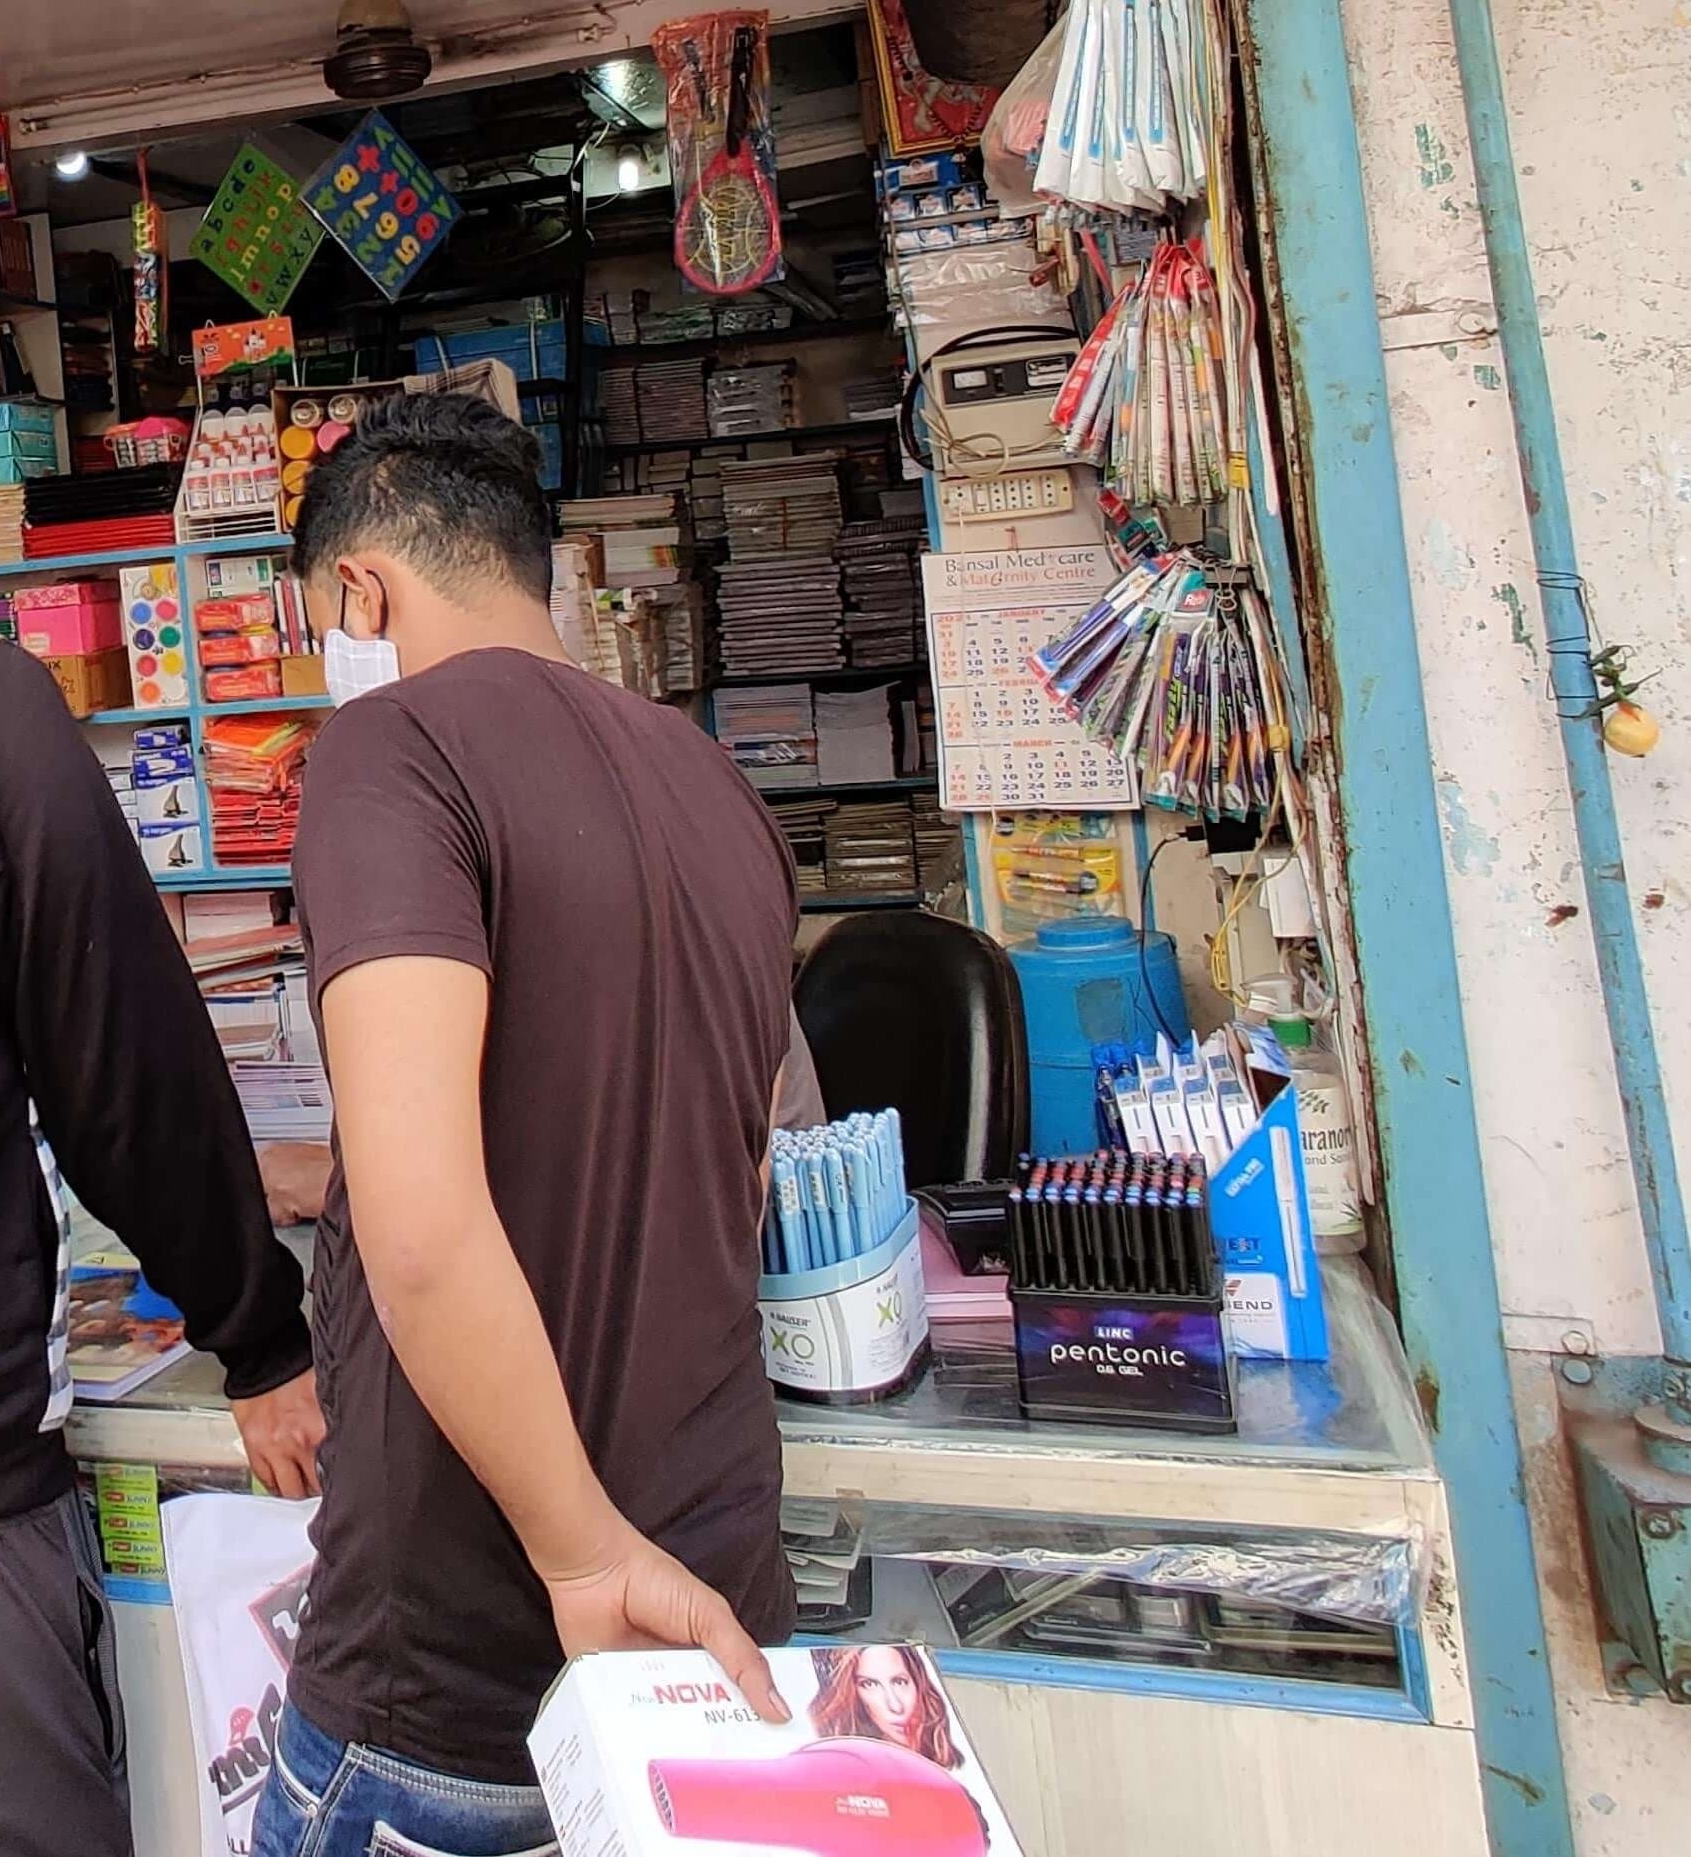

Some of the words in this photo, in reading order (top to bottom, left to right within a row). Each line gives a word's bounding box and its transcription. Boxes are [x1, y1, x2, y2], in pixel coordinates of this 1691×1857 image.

[998, 678, 1039, 687] FEBRUA
[770, 1326, 815, 1359] XO
[1050, 1342, 1187, 1367] pentonic
[1119, 1365, 1144, 1376] GEL
[653, 1681, 732, 1705] NOVA
